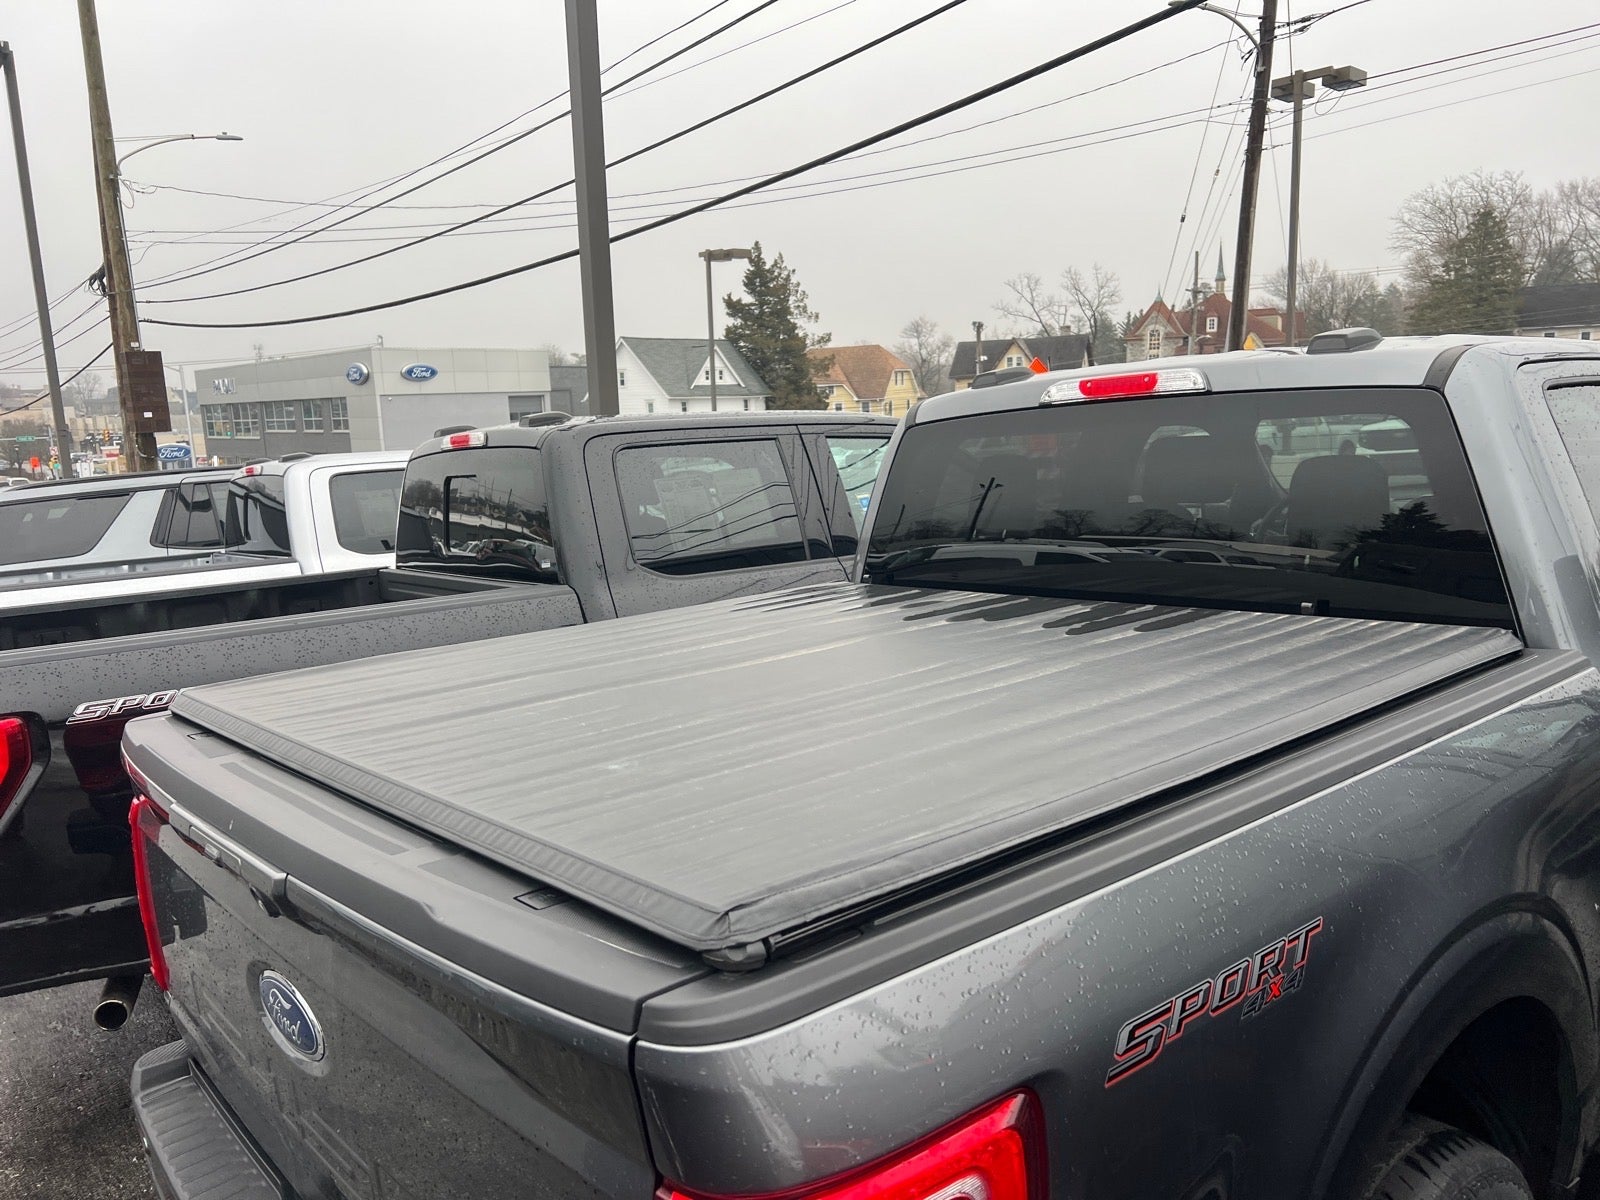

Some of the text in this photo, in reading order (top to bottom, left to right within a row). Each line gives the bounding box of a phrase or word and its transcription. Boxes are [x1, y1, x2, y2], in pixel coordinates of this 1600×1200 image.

[411, 367, 431, 378] Ford
[159, 447, 186, 458] Ford
[66, 689, 178, 725] SPO
[268, 988, 301, 1044] Ford
[1105, 916, 1323, 1088] SPORT
